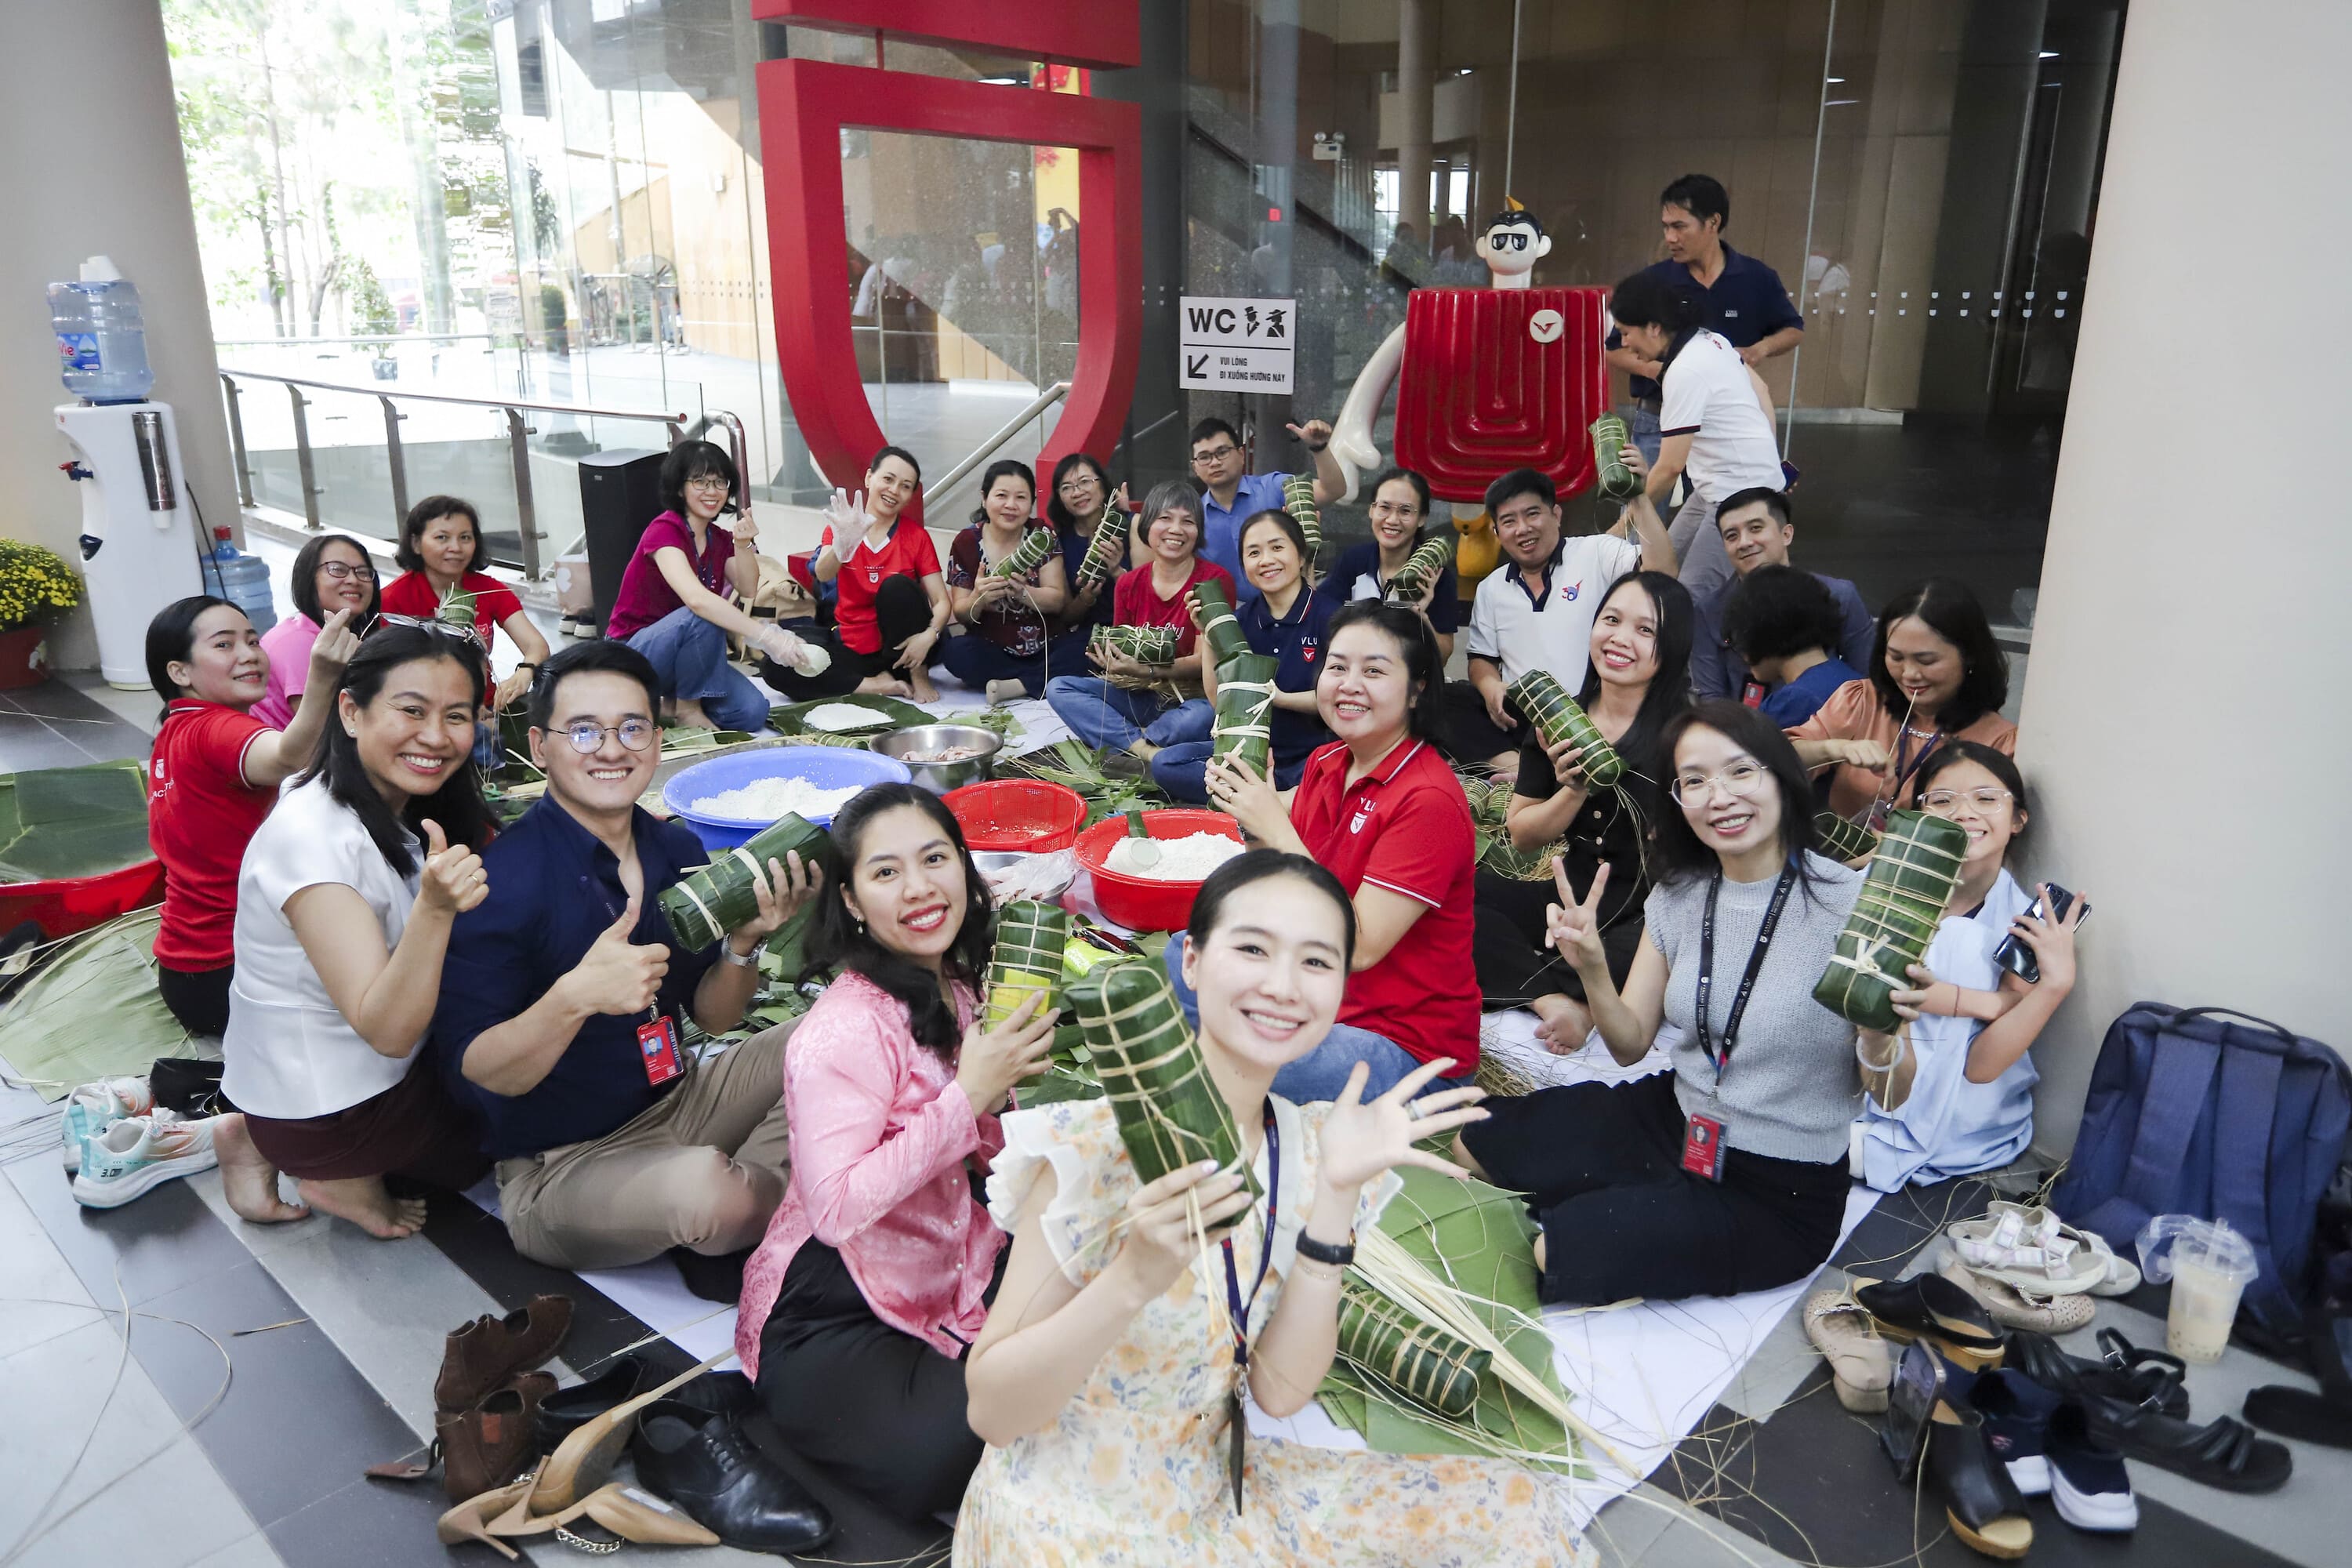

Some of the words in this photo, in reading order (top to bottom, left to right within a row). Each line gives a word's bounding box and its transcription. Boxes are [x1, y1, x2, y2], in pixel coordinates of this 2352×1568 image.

[1188, 307, 1236, 334] WC
[1220, 357, 1230, 365] VUI
[1219, 371, 1226, 379] ĐI
[1301, 637, 1317, 645] VLU
